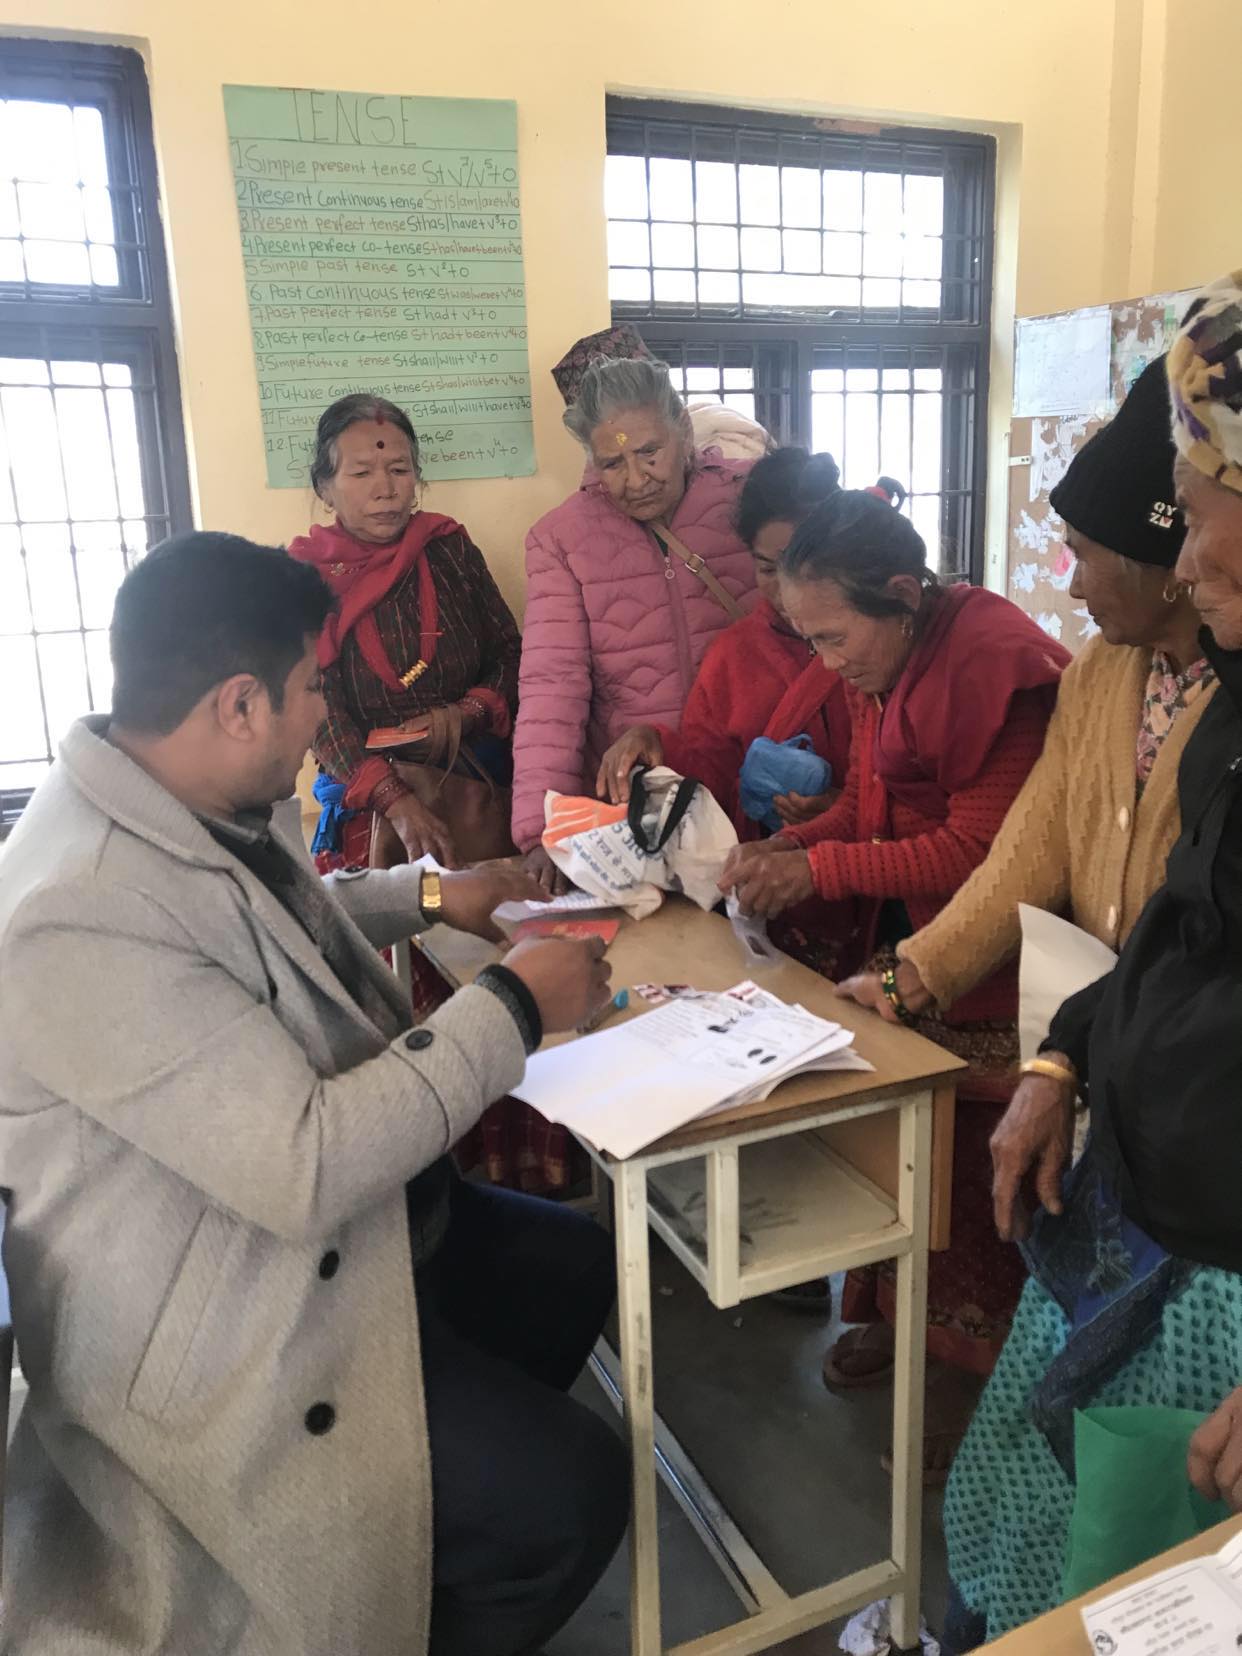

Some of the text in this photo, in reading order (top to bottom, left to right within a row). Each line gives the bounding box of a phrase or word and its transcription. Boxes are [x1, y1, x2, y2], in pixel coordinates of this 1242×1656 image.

[277, 87, 417, 146] TENSE
[312, 159, 367, 184] present
[370, 160, 417, 177] tense
[318, 189, 387, 208] Continuous
[389, 195, 424, 210] tense
[316, 214, 366, 235] perfect
[369, 217, 406, 232] tense
[308, 237, 356, 258] perfect
[317, 259, 349, 278] past
[355, 261, 398, 274] tense
[269, 283, 303, 301] Past
[401, 287, 436, 300] tense
[300, 305, 352, 322] perfect
[356, 306, 397, 319] tense
[302, 327, 350, 349] perfect
[357, 355, 391, 368] tense
[274, 383, 323, 402] Future
[392, 382, 421, 394] tense
